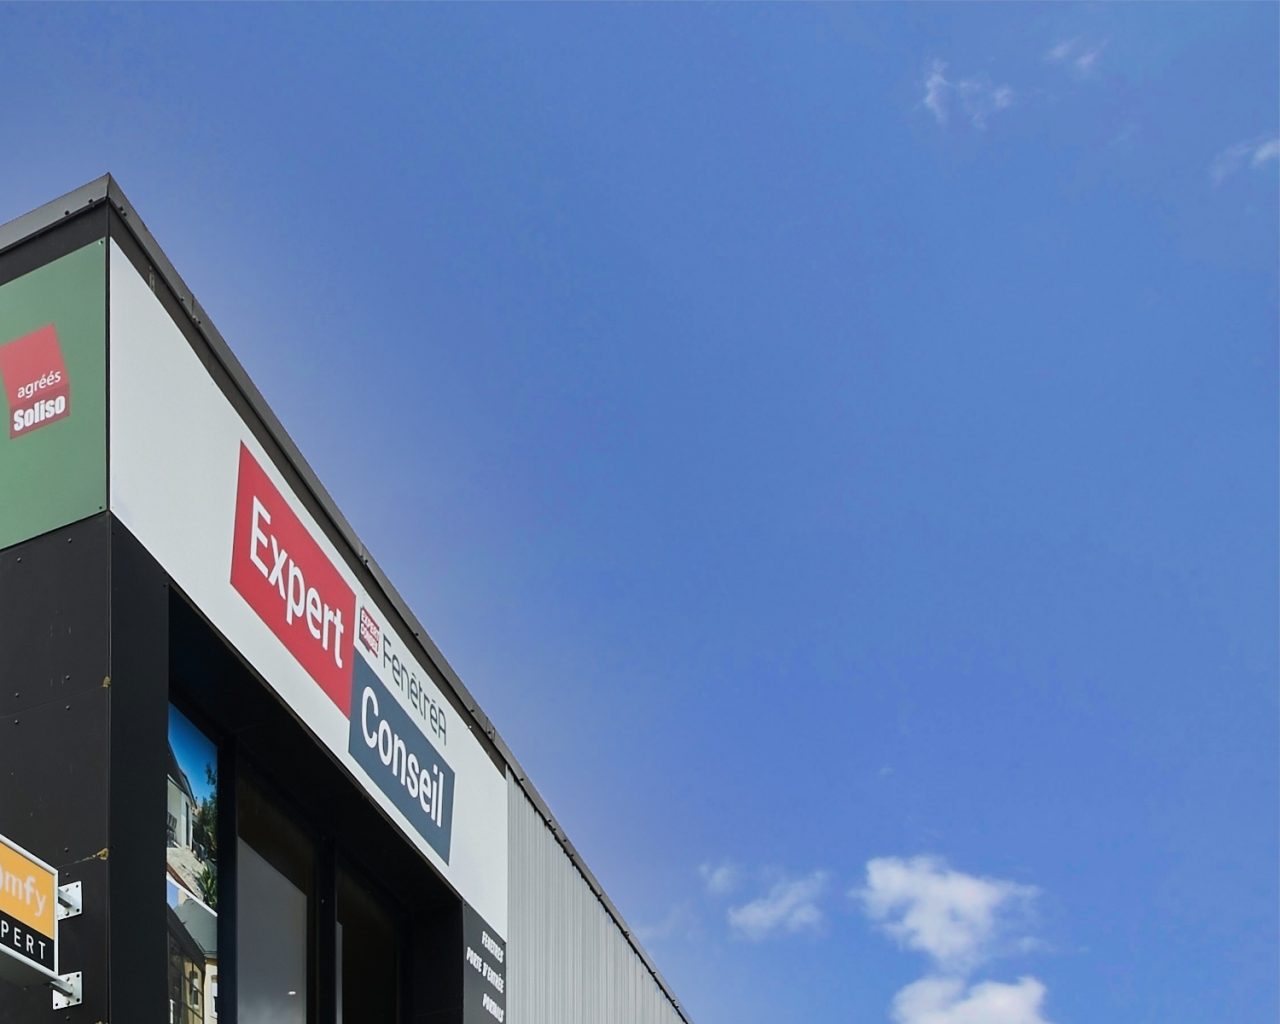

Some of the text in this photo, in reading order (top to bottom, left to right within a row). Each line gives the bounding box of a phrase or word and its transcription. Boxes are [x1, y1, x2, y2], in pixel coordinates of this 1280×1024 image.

[13, 395, 66, 432] Soliso
[17, 369, 62, 400] agréés
[249, 495, 344, 669] Expert
[360, 686, 444, 827] Conseil
